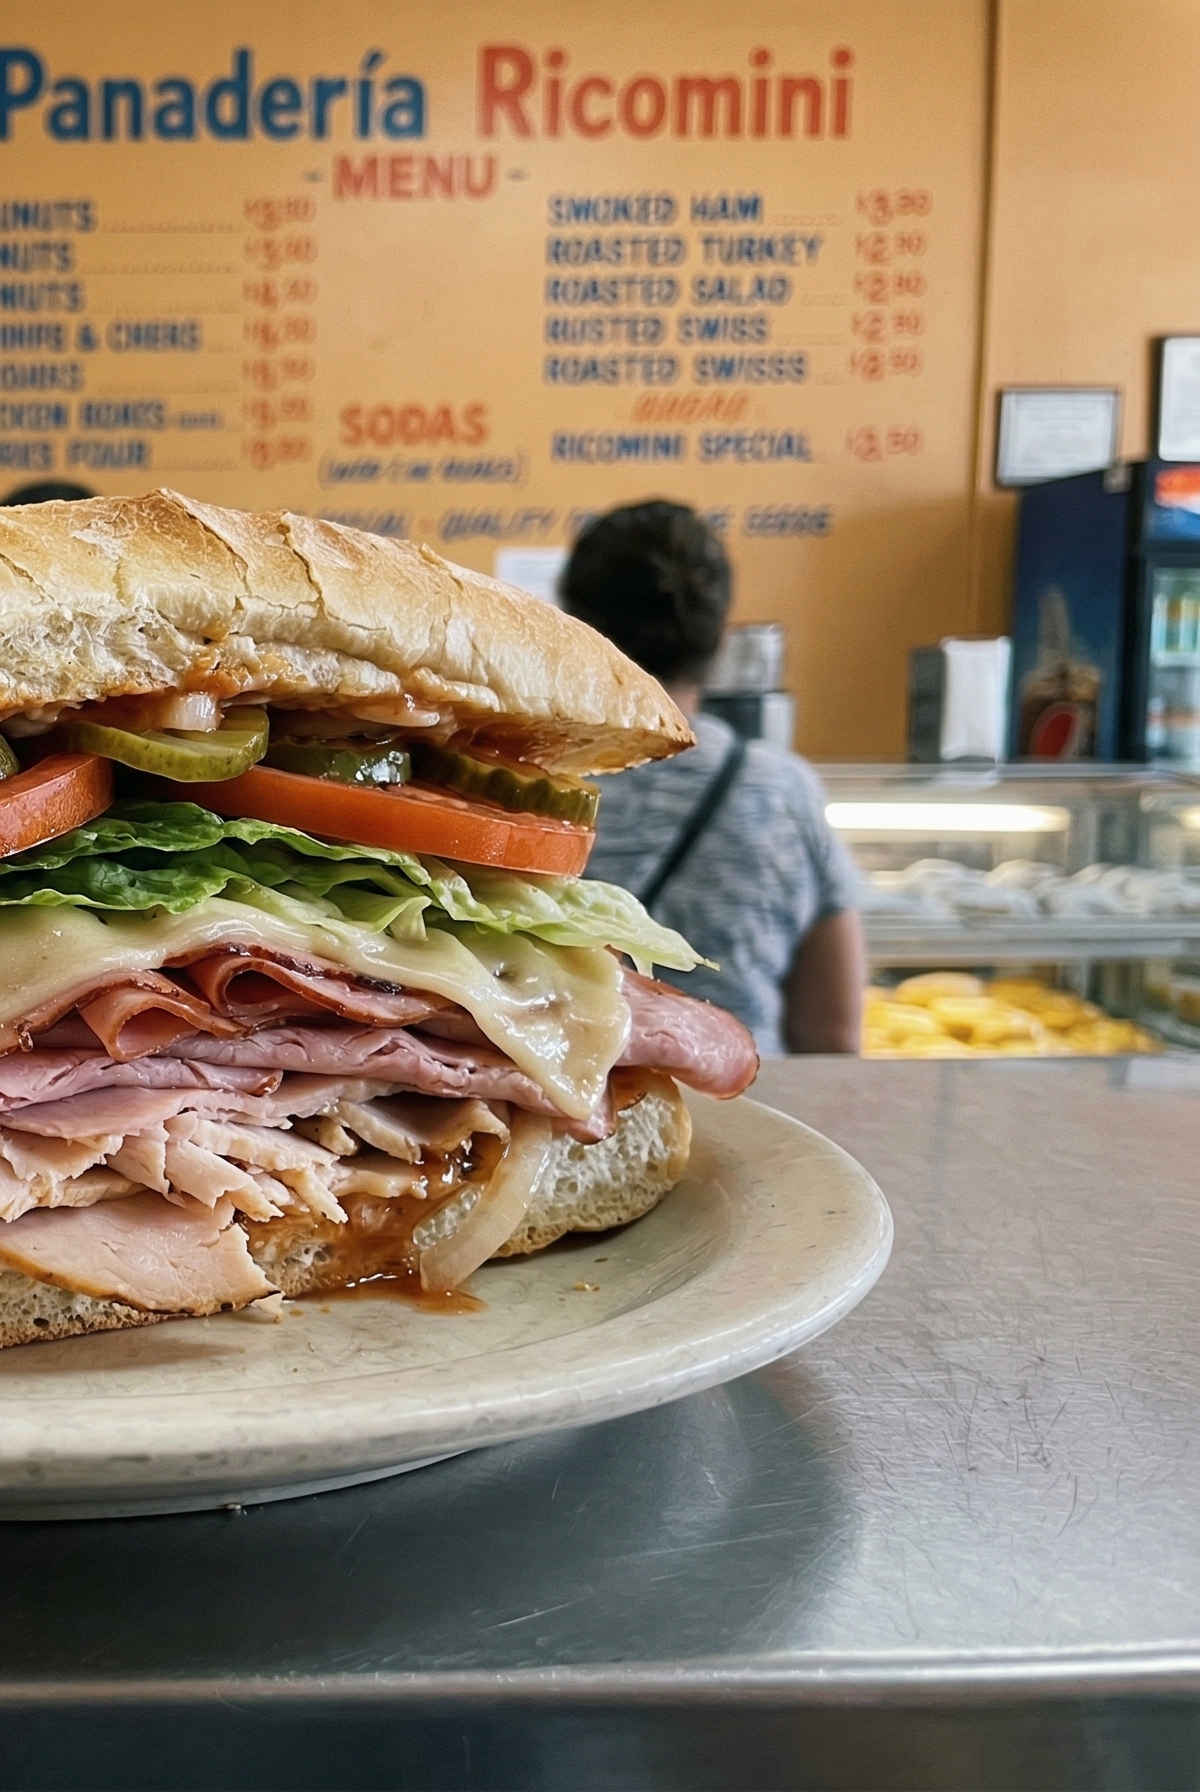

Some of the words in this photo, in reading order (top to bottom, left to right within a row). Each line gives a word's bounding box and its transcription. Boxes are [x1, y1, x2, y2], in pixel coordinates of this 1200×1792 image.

[479, 43, 853, 140] Ricomini
[334, 155, 496, 199] MENU
[550, 194, 676, 226] SMOKED
[690, 194, 763, 222] HAM
[547, 235, 686, 266] ROASTED
[703, 233, 822, 266] TURKEY
[547, 275, 679, 306] ROASTED
[544, 354, 679, 384] ROASTED
[340, 402, 488, 447] SODAS
[552, 433, 683, 463] RICOMINI
[699, 432, 812, 463] SPECIAL
